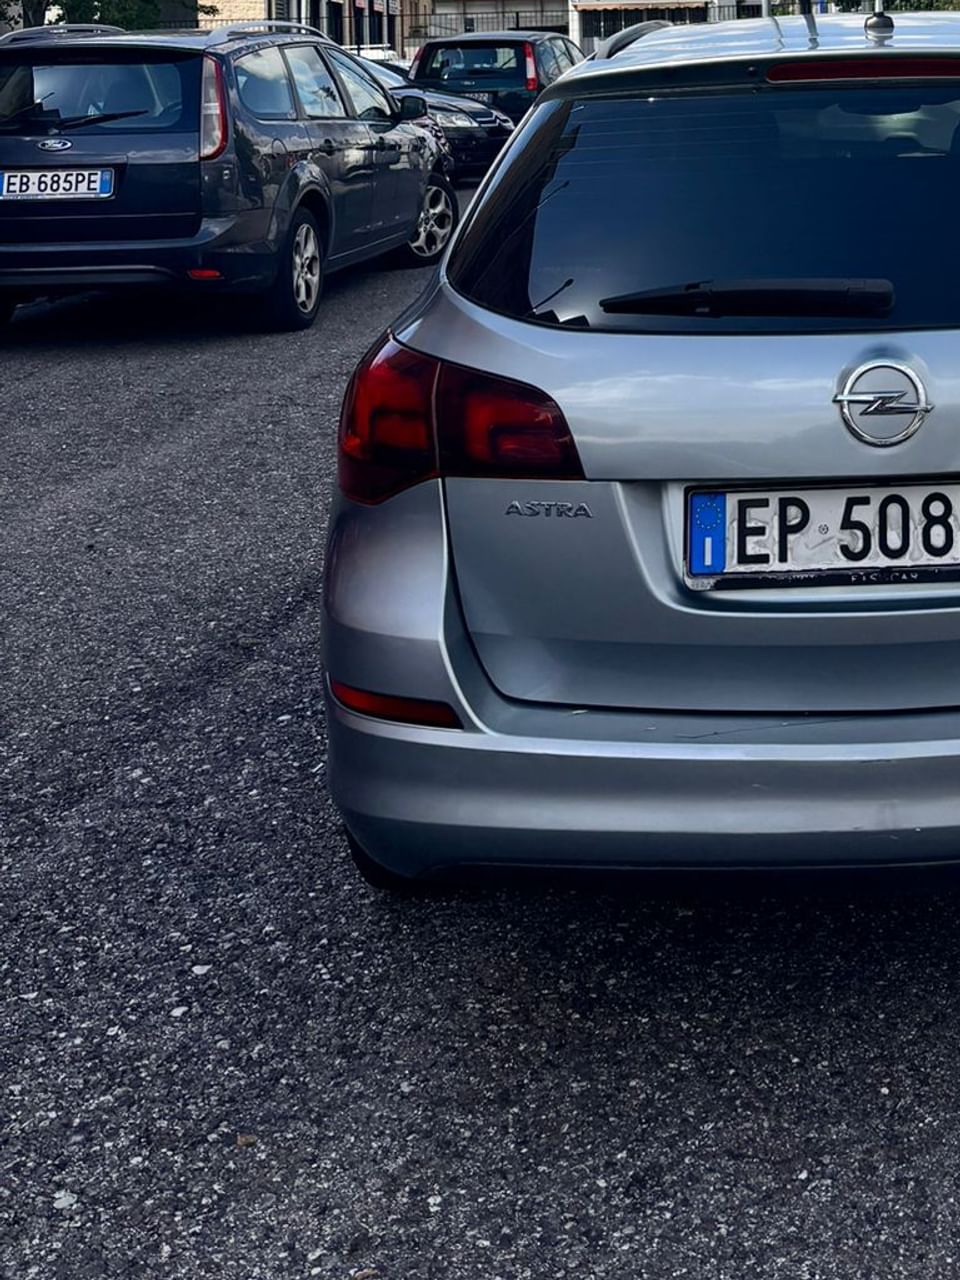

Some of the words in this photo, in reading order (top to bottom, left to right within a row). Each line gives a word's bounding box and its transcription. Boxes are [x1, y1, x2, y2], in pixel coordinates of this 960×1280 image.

[6, 173, 30, 194] EB
[37, 172, 98, 192] 685PE
[505, 500, 593, 518] ASTRA
[737, 496, 811, 565] EP
